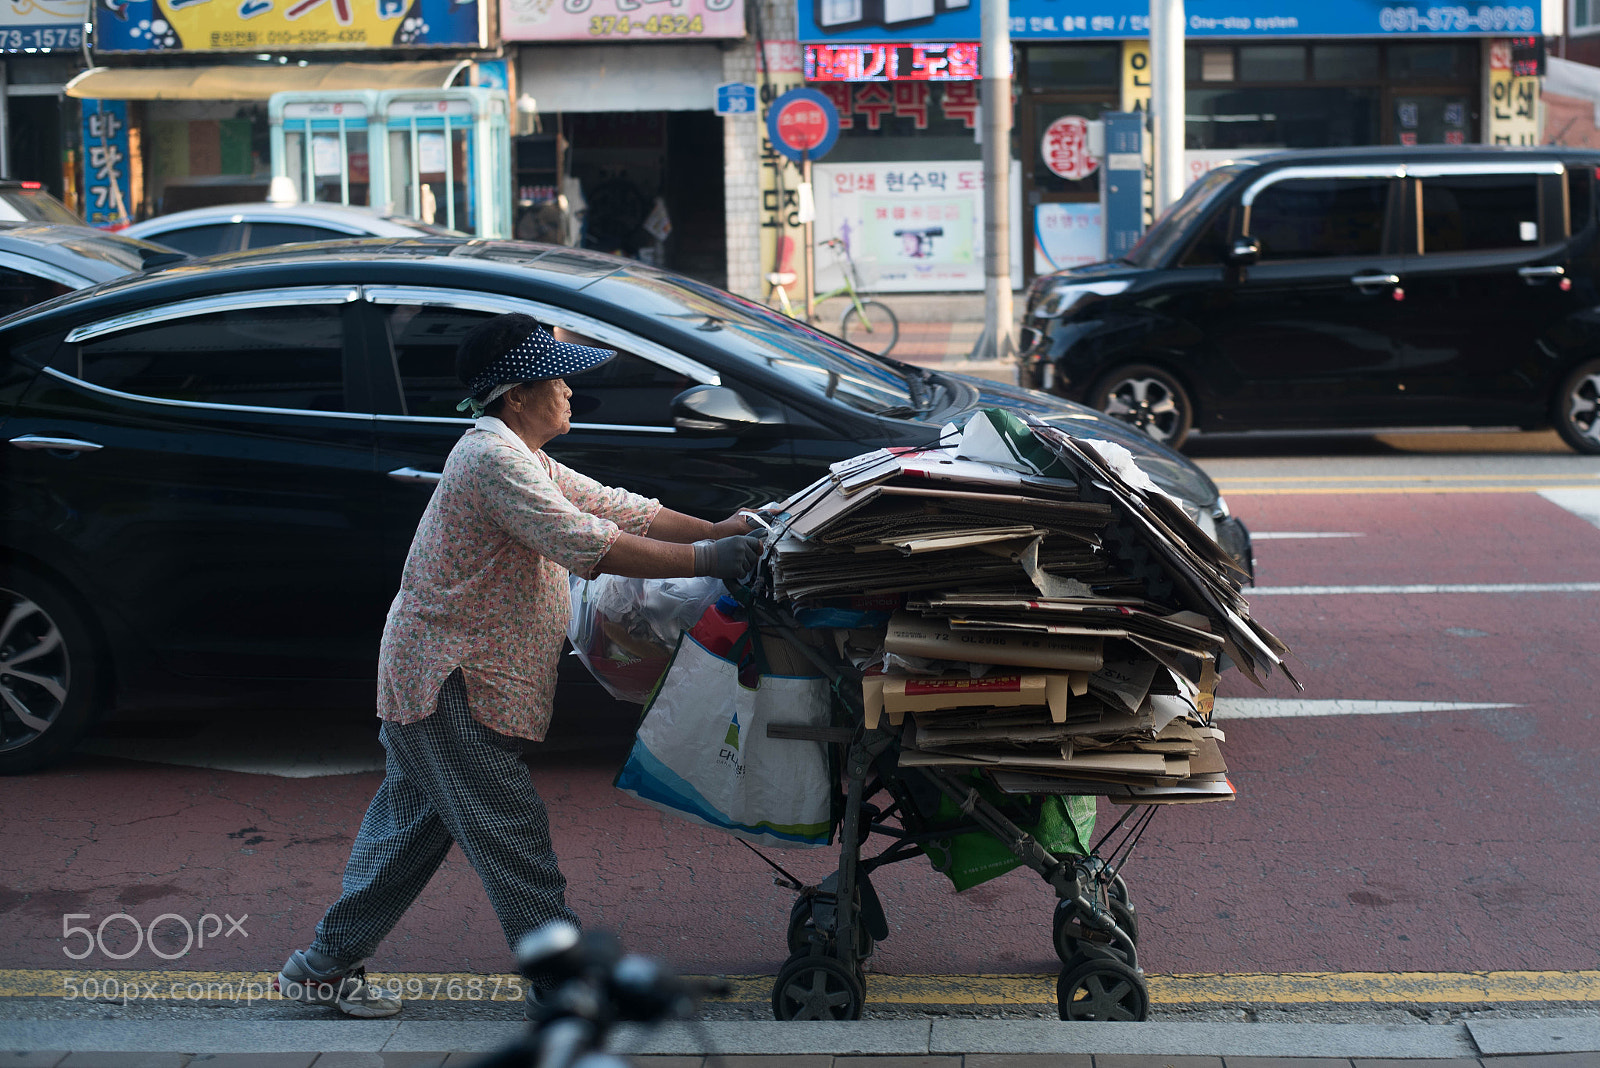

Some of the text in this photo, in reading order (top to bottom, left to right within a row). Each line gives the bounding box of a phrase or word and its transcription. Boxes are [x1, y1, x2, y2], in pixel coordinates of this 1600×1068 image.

[589, 15, 704, 35] 374-4524
[1190, 14, 1298, 30] One-stop system
[728, 97, 748, 113] 30
[835, 172, 877, 194] 인쇄
[885, 170, 948, 193] 현수막
